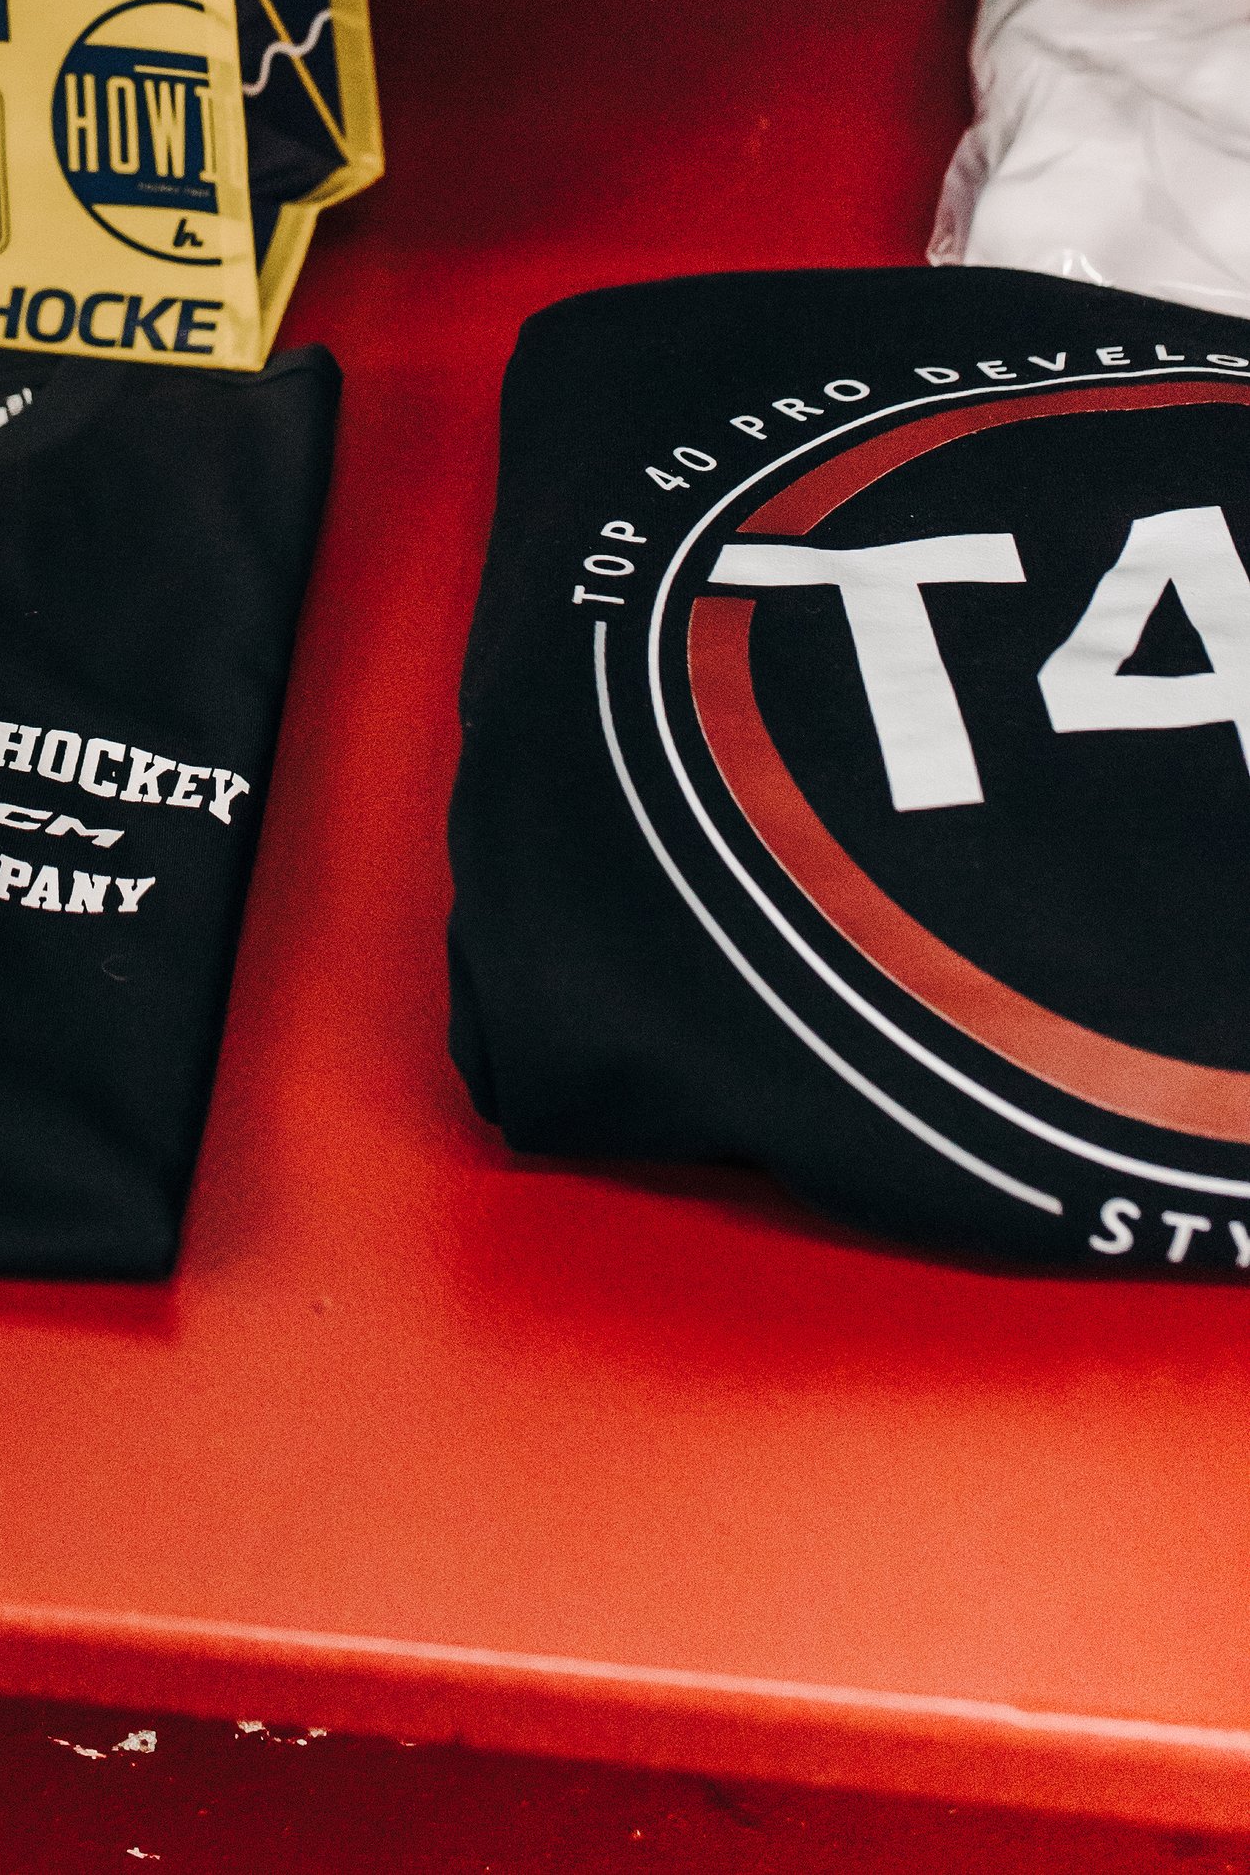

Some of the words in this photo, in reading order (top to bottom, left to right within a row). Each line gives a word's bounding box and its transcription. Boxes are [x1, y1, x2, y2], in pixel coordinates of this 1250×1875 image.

[572, 520, 647, 605] TOP
[646, 446, 717, 491] 40
[730, 379, 870, 440] PRO
[914, 344, 1250, 384] DEVELO
